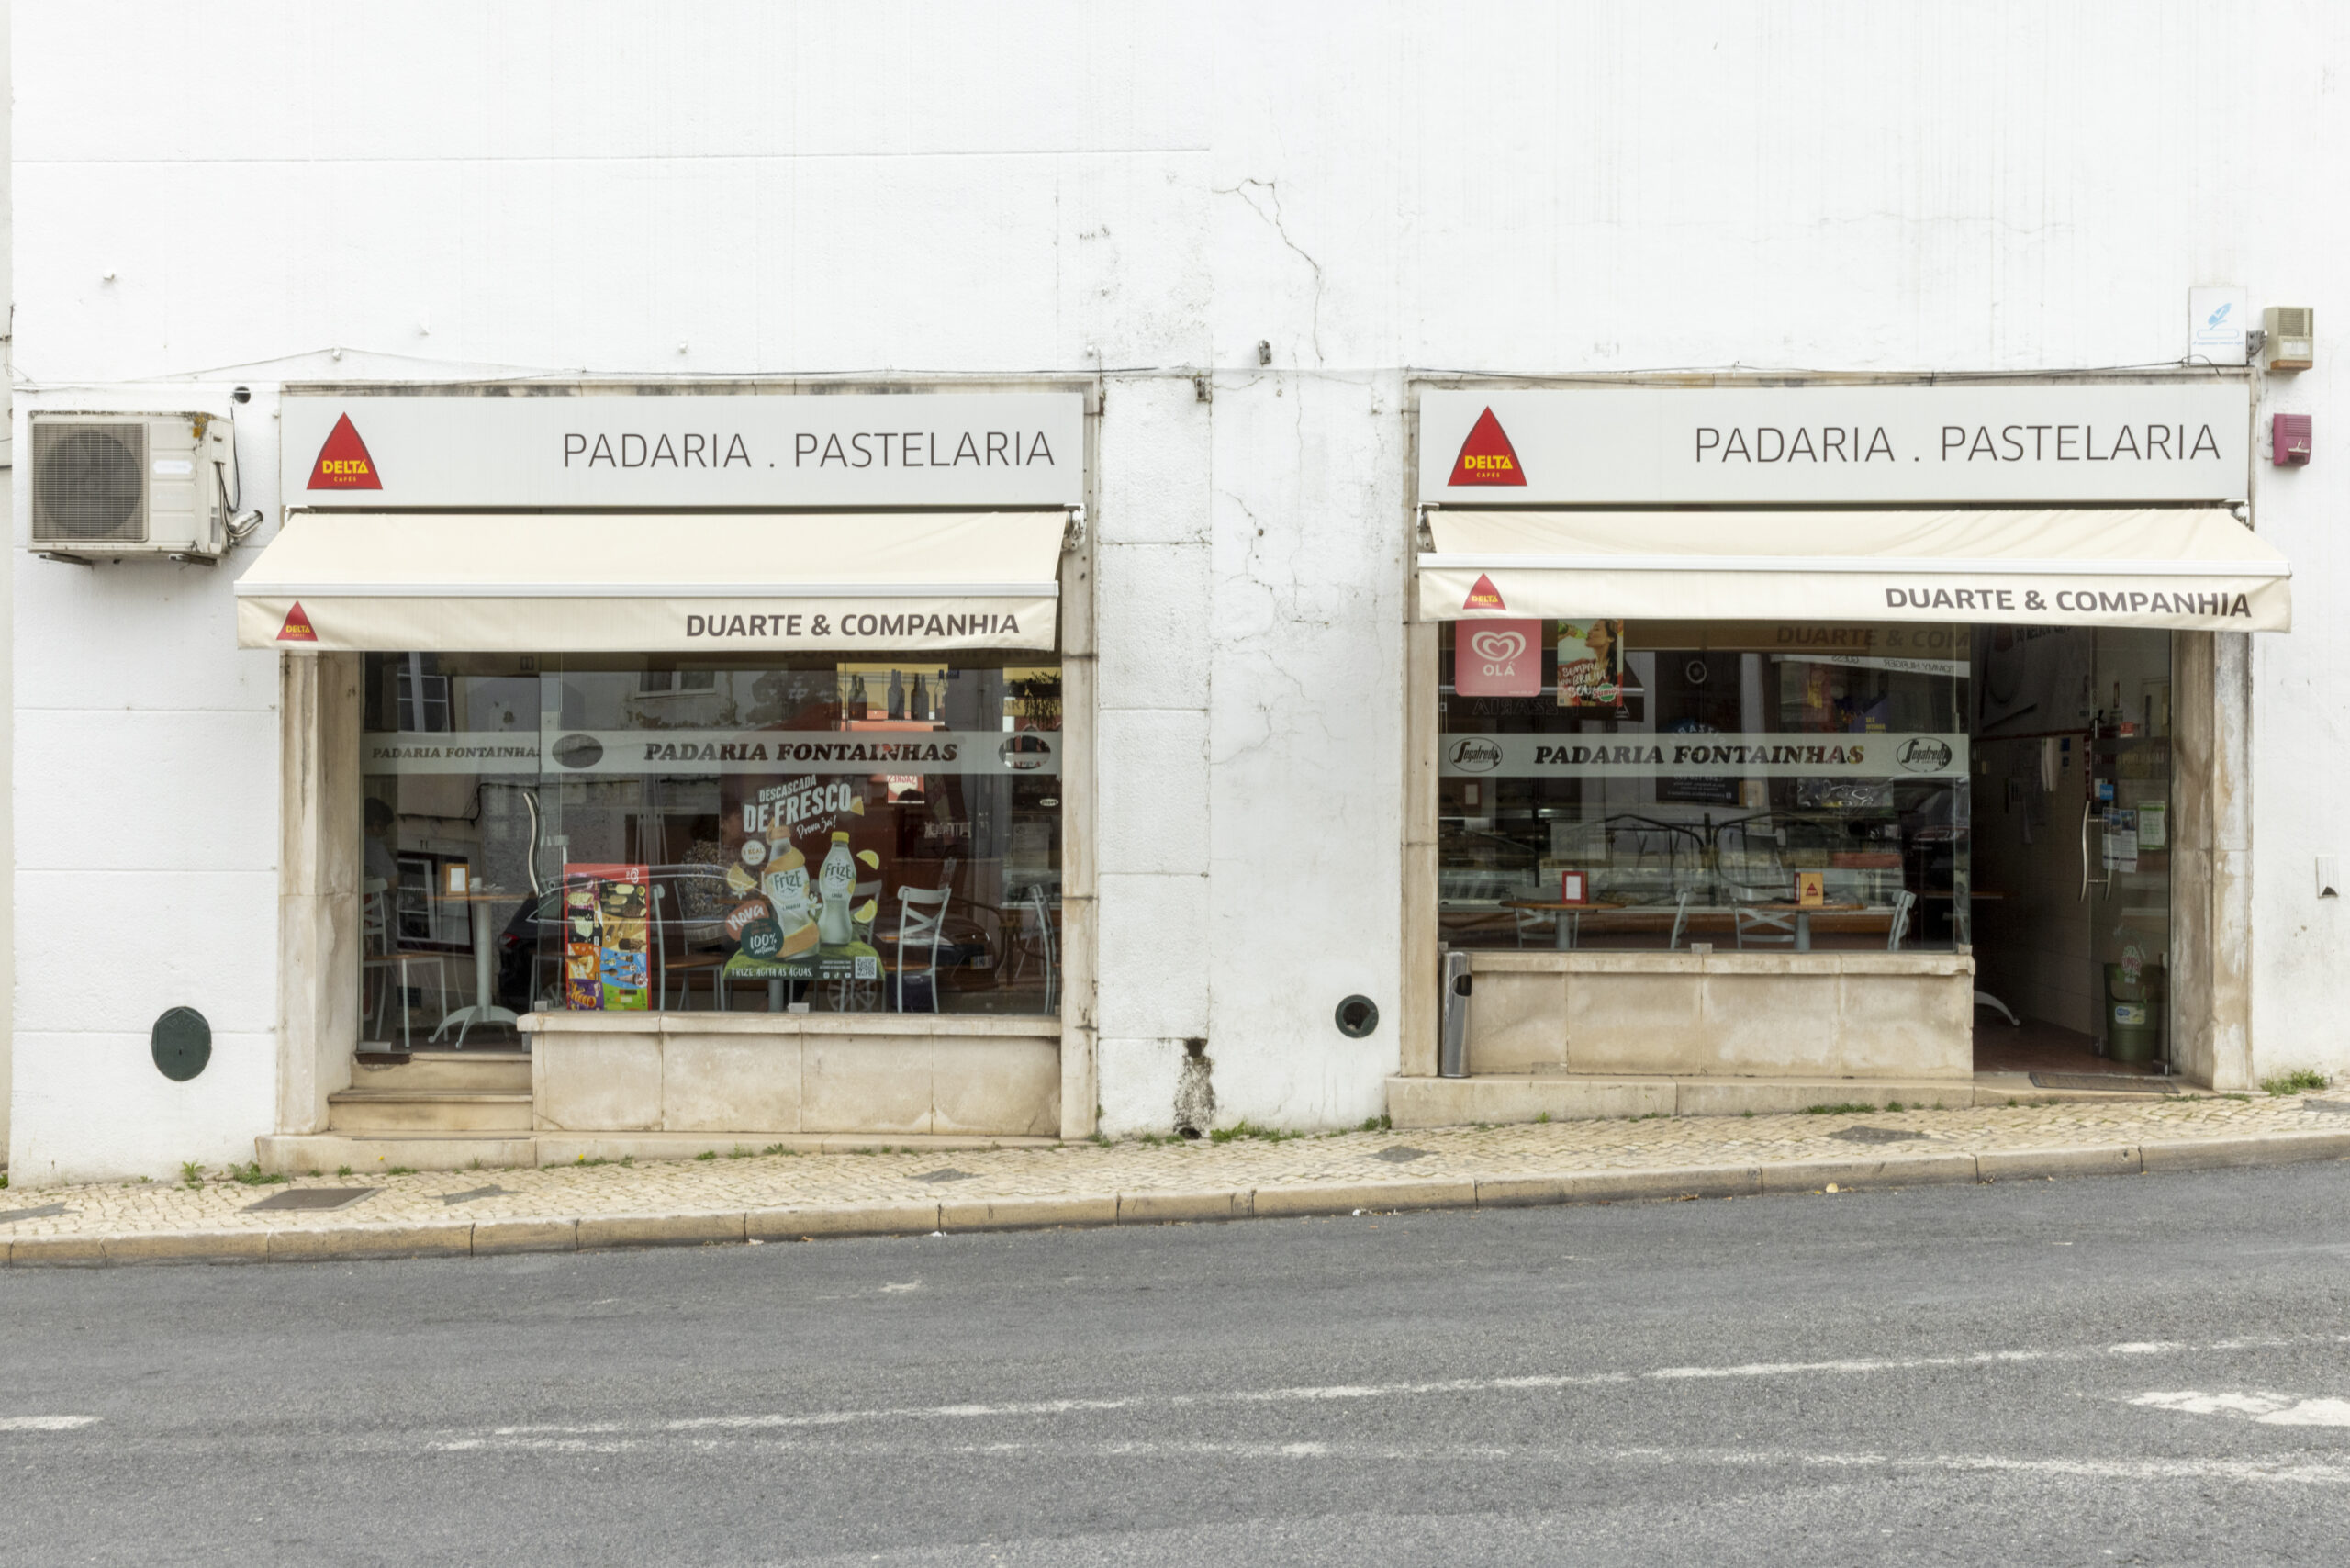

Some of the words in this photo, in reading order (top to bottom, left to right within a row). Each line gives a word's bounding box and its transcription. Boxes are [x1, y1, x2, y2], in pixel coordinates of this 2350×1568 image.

[564, 433, 752, 468] PADARIA
[795, 431, 1055, 468] PASTELARIA
[1695, 427, 1895, 463] PADARIA
[1942, 424, 2221, 462] PASTELARIA
[322, 460, 369, 474] DELTA
[1464, 455, 1513, 469] DELTA
[1472, 595, 1498, 603] DELTA
[1886, 588, 2015, 610] DUARTE
[2024, 590, 2047, 610] &
[2056, 590, 2253, 619] COMPANHIA
[285, 624, 310, 633] DELTA
[686, 614, 802, 637] DUARTE
[811, 614, 831, 636] &
[840, 613, 1021, 636] COMPANHIA
[1776, 626, 1876, 647] DUARTE
[1483, 661, 1515, 677] OLÁ
[372, 747, 441, 758] PADARIA
[644, 742, 769, 761] PADARIA
[776, 742, 958, 761] FONTAINHAS
[1453, 740, 1500, 764] Segafredo
[1533, 745, 1664, 764] PADARIA
[1673, 745, 1864, 765] FONTAINHAS
[759, 774, 817, 803] DESCASCADA
[744, 803, 769, 833] DE
[774, 783, 852, 828] FRESCO
[796, 822, 821, 840] Prova
[750, 933, 778, 950] 100%
